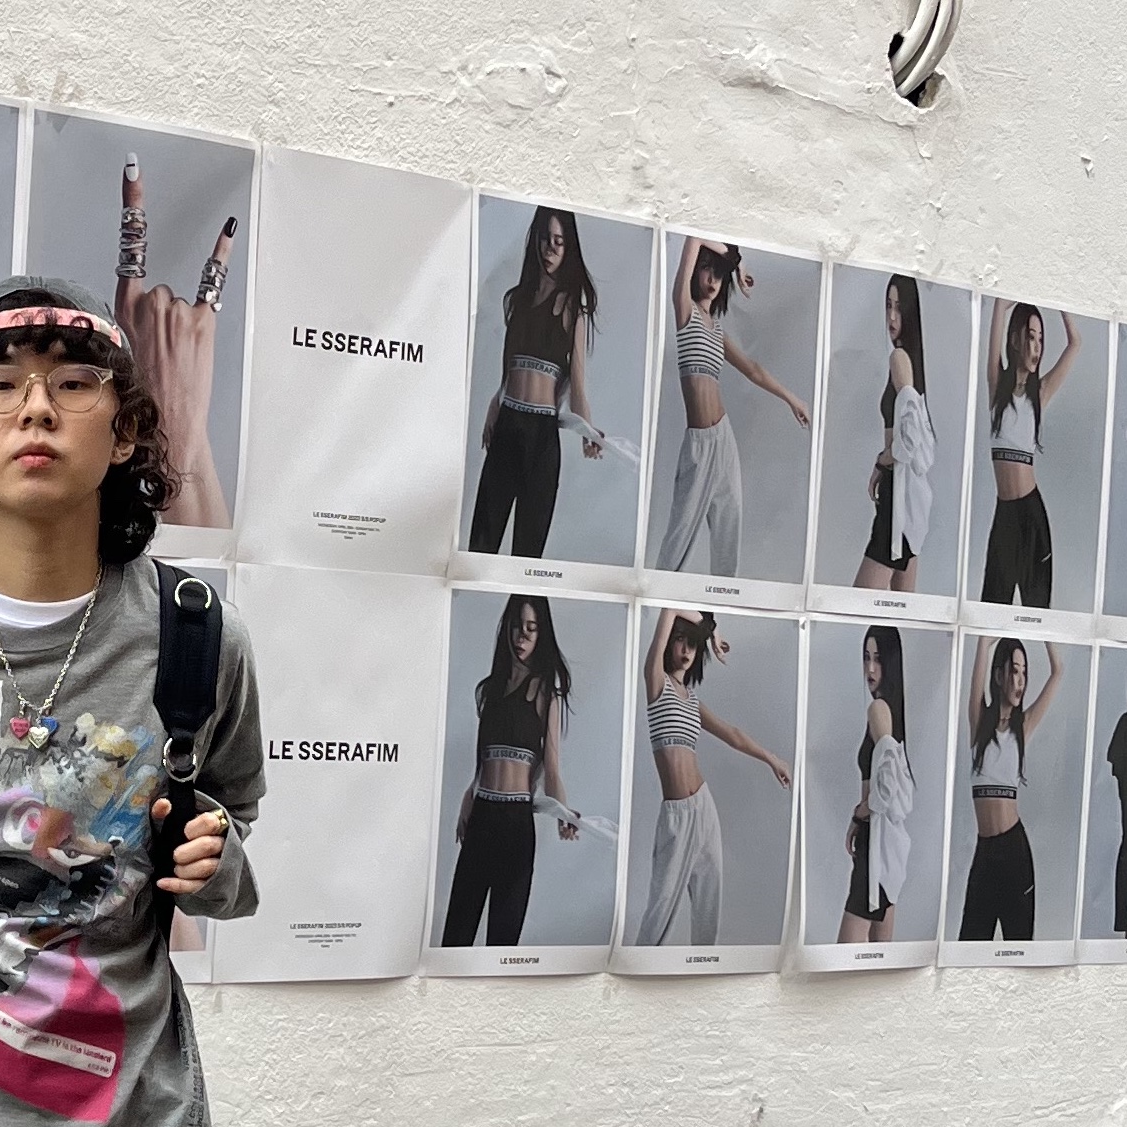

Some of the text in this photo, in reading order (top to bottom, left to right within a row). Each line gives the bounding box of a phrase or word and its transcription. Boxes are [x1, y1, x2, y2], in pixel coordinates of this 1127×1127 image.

[292, 326, 424, 364] LE SSERAFIM
[268, 740, 399, 763] LE SSERAFIM
[499, 957, 540, 965] LE SSERAFIM
